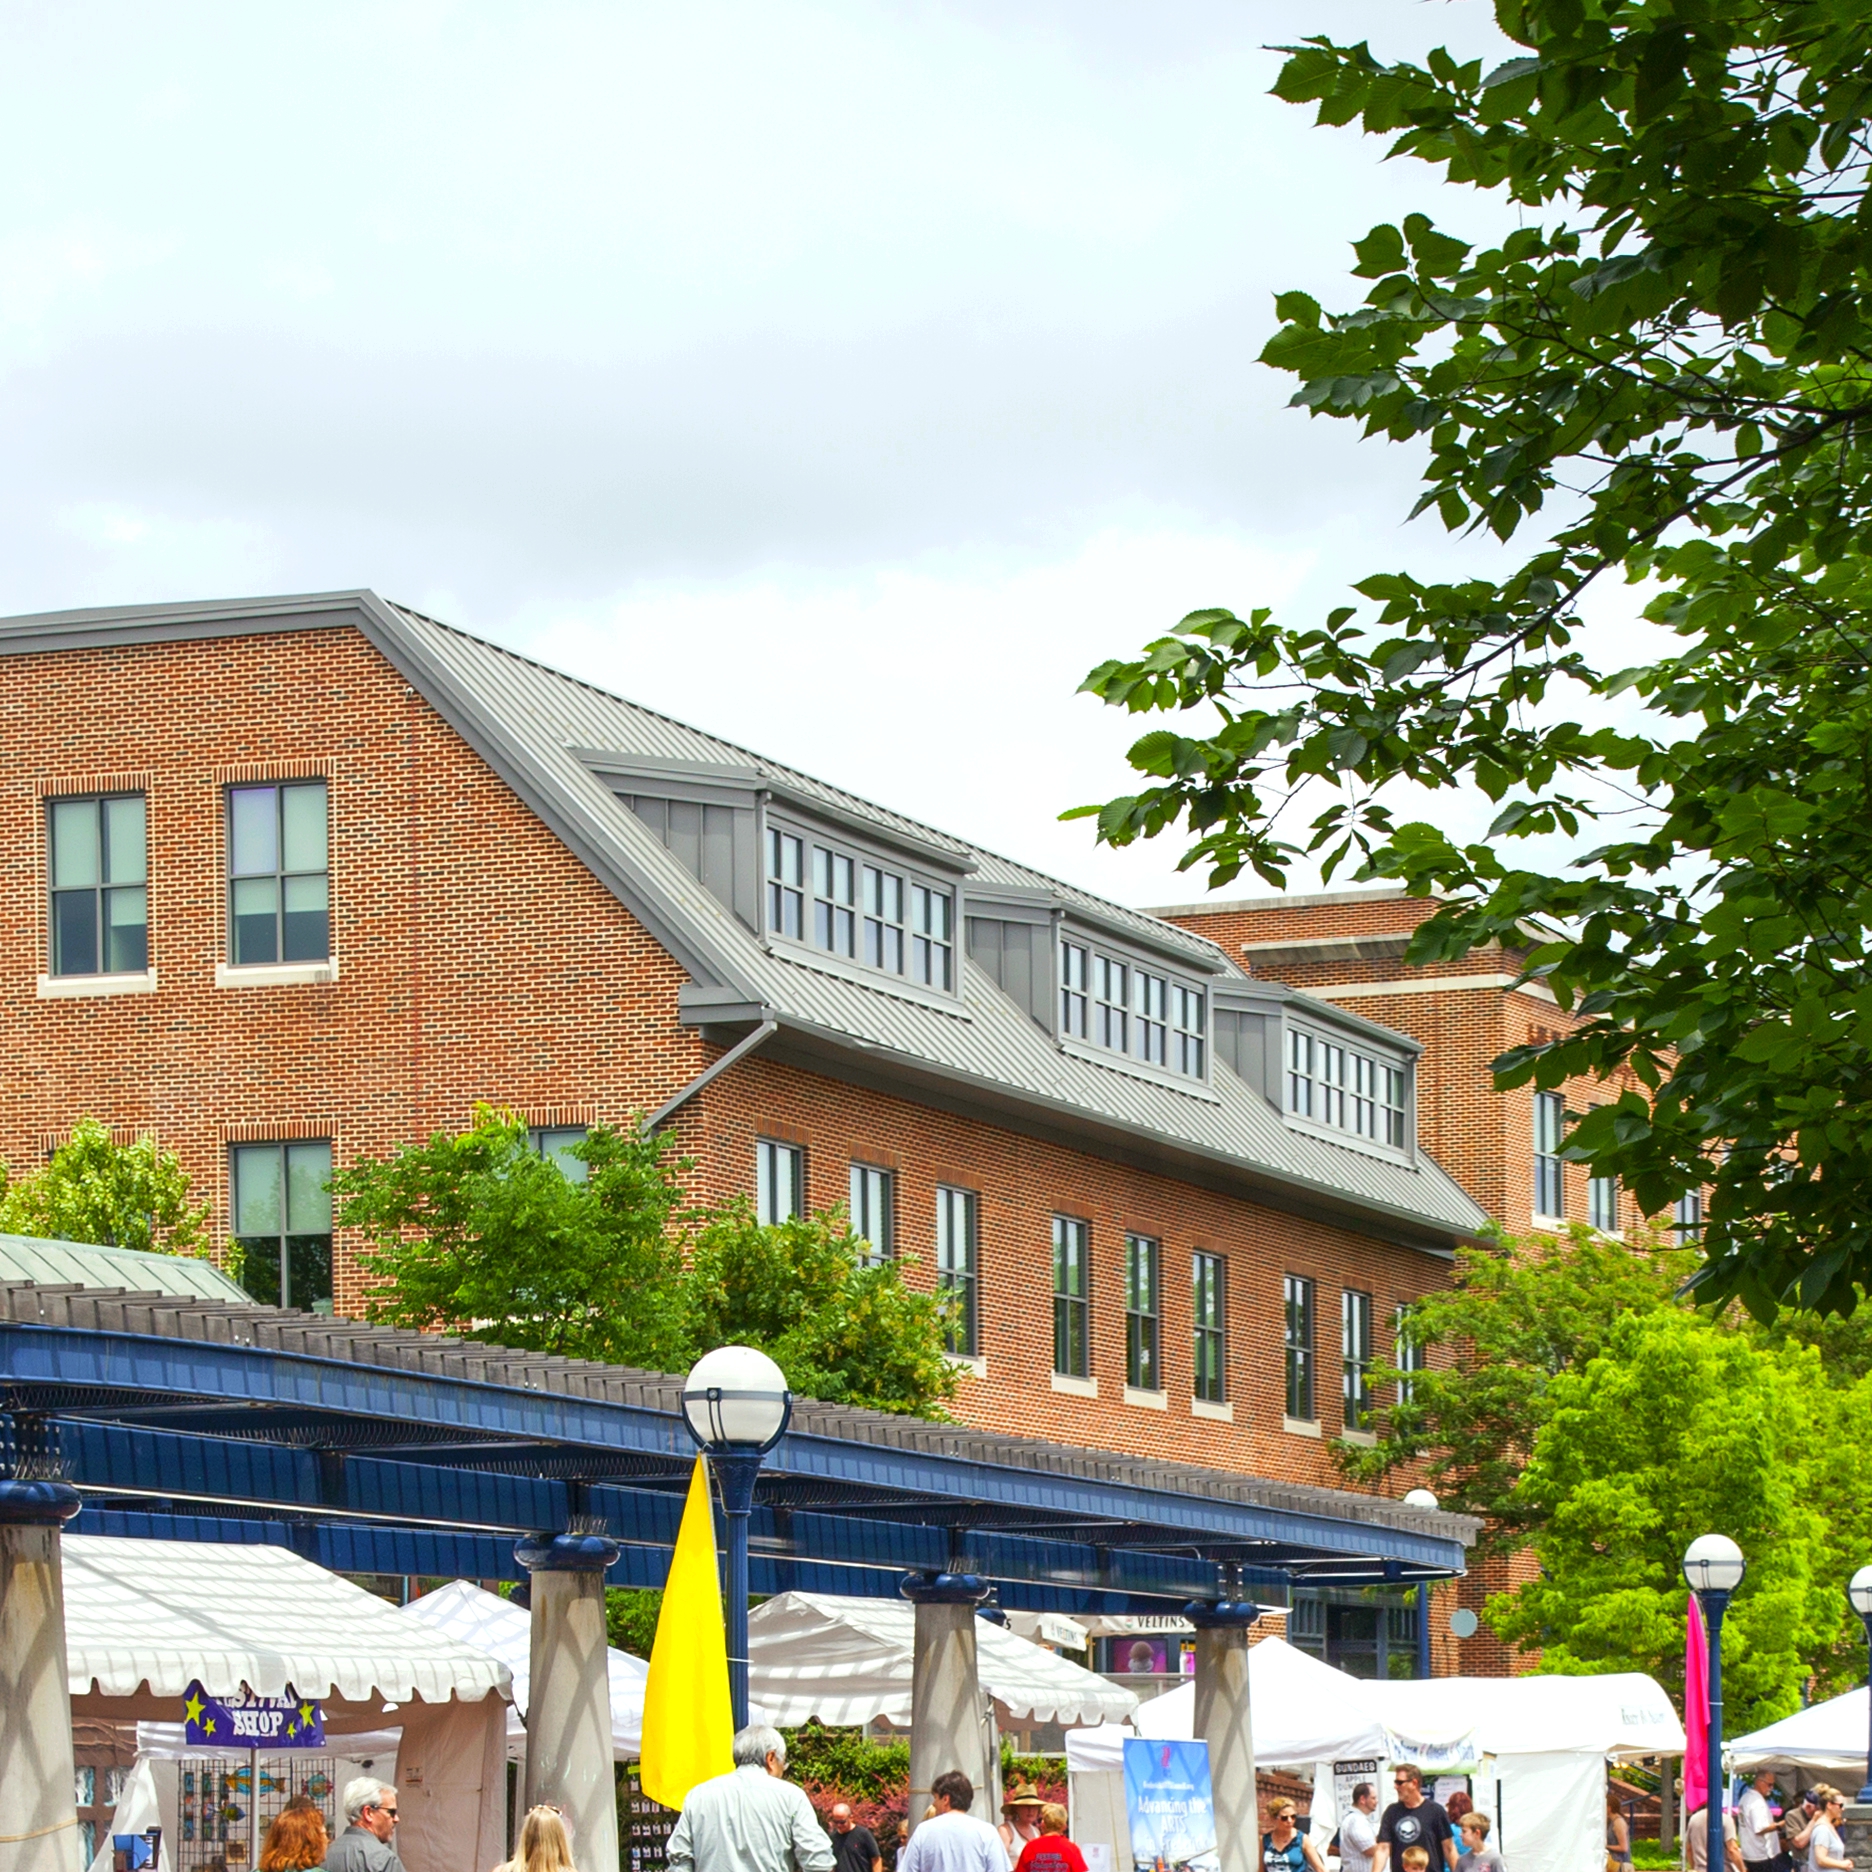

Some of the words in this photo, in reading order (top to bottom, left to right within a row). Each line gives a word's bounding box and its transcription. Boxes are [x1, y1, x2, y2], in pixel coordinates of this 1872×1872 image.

[1137, 1615, 1185, 1628] VELTINS
[232, 1710, 284, 1737] SHOP
[1335, 1761, 1376, 1774] SUNDAES
